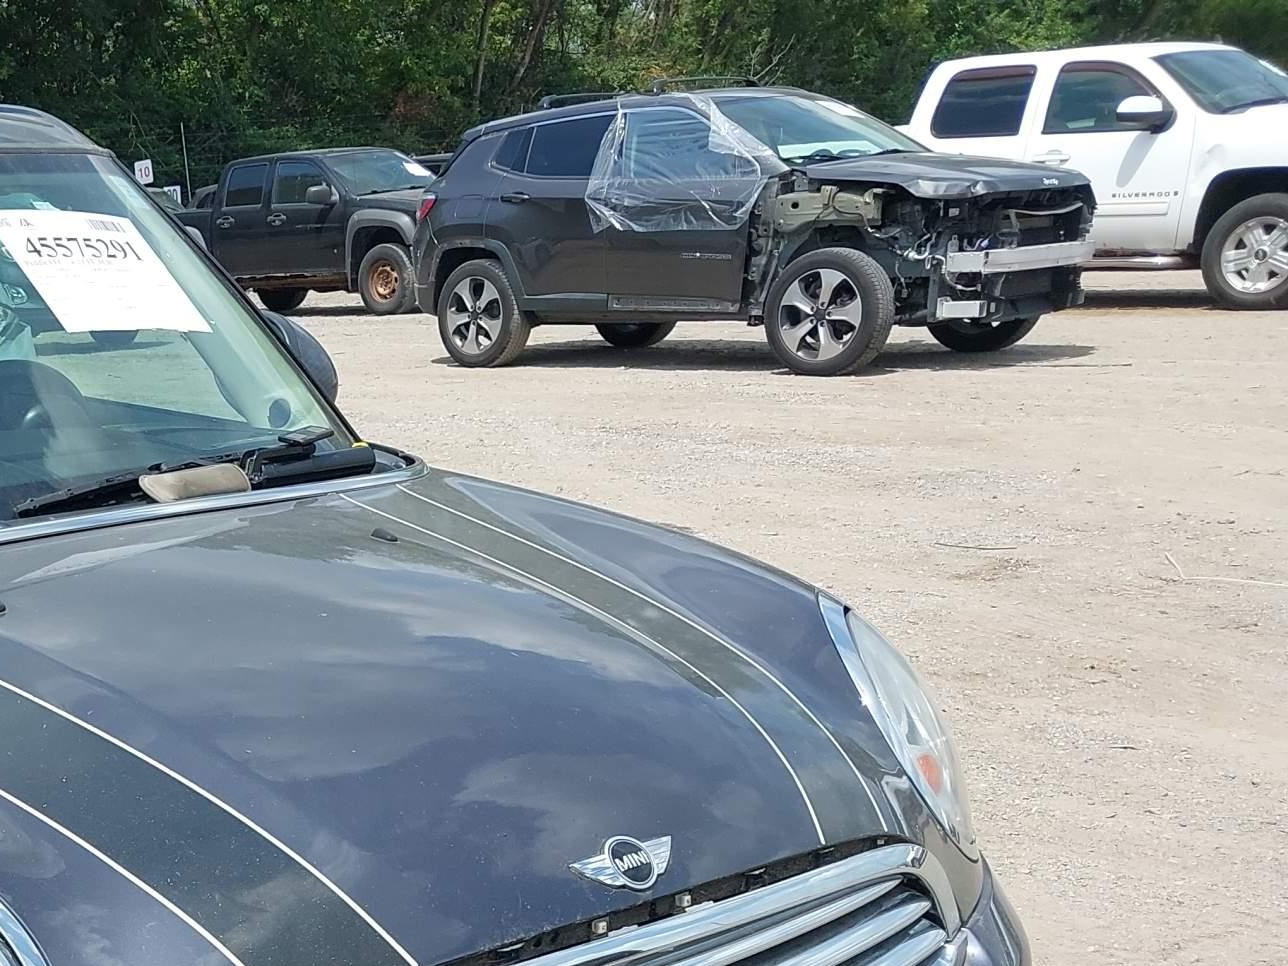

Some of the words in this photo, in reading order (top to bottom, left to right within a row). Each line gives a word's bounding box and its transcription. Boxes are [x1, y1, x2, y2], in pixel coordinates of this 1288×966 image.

[138, 166, 150, 178] 10
[26, 237, 143, 261] 45575291
[615, 850, 650, 872] MINI
